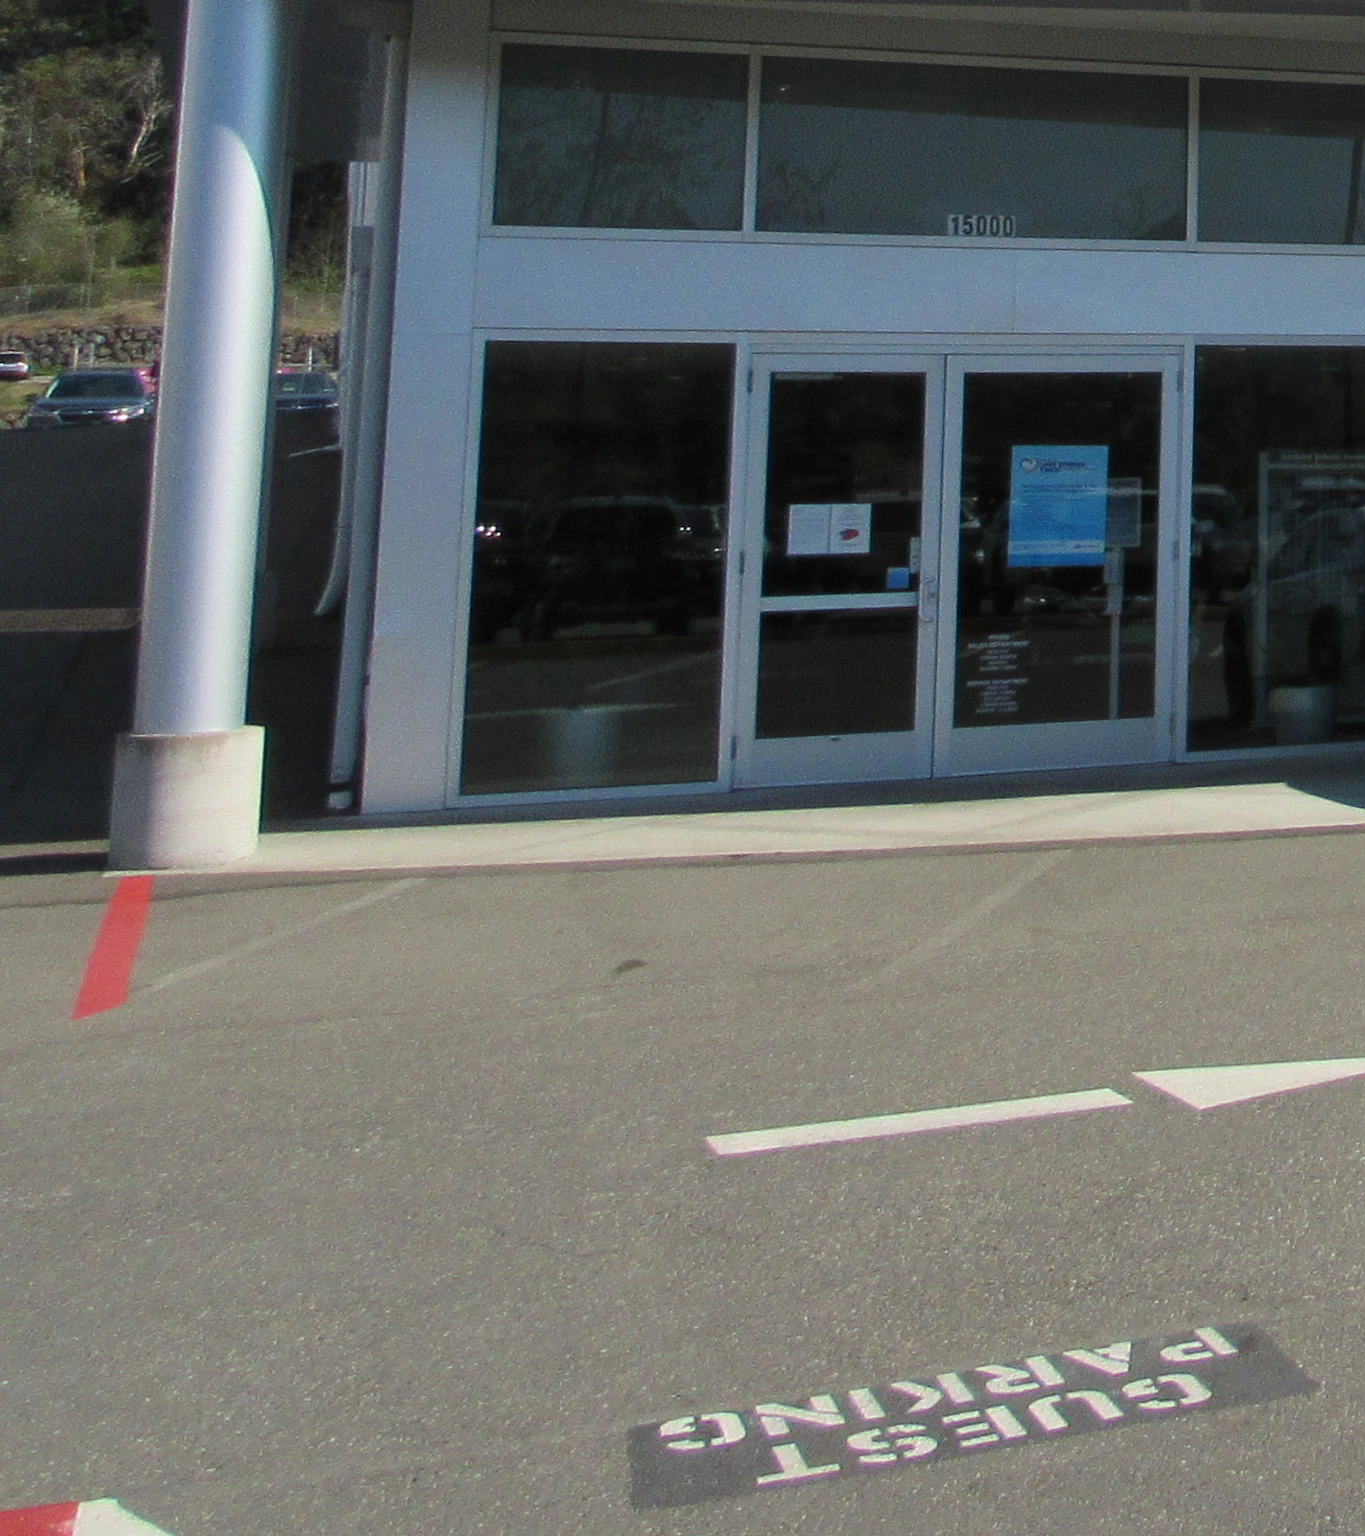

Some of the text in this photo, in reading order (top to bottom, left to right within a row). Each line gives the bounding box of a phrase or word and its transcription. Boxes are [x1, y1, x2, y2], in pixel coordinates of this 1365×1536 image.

[950, 215, 1014, 236] 15000
[659, 1325, 1239, 1452] PARKING
[756, 1373, 1213, 1486] GUEST
